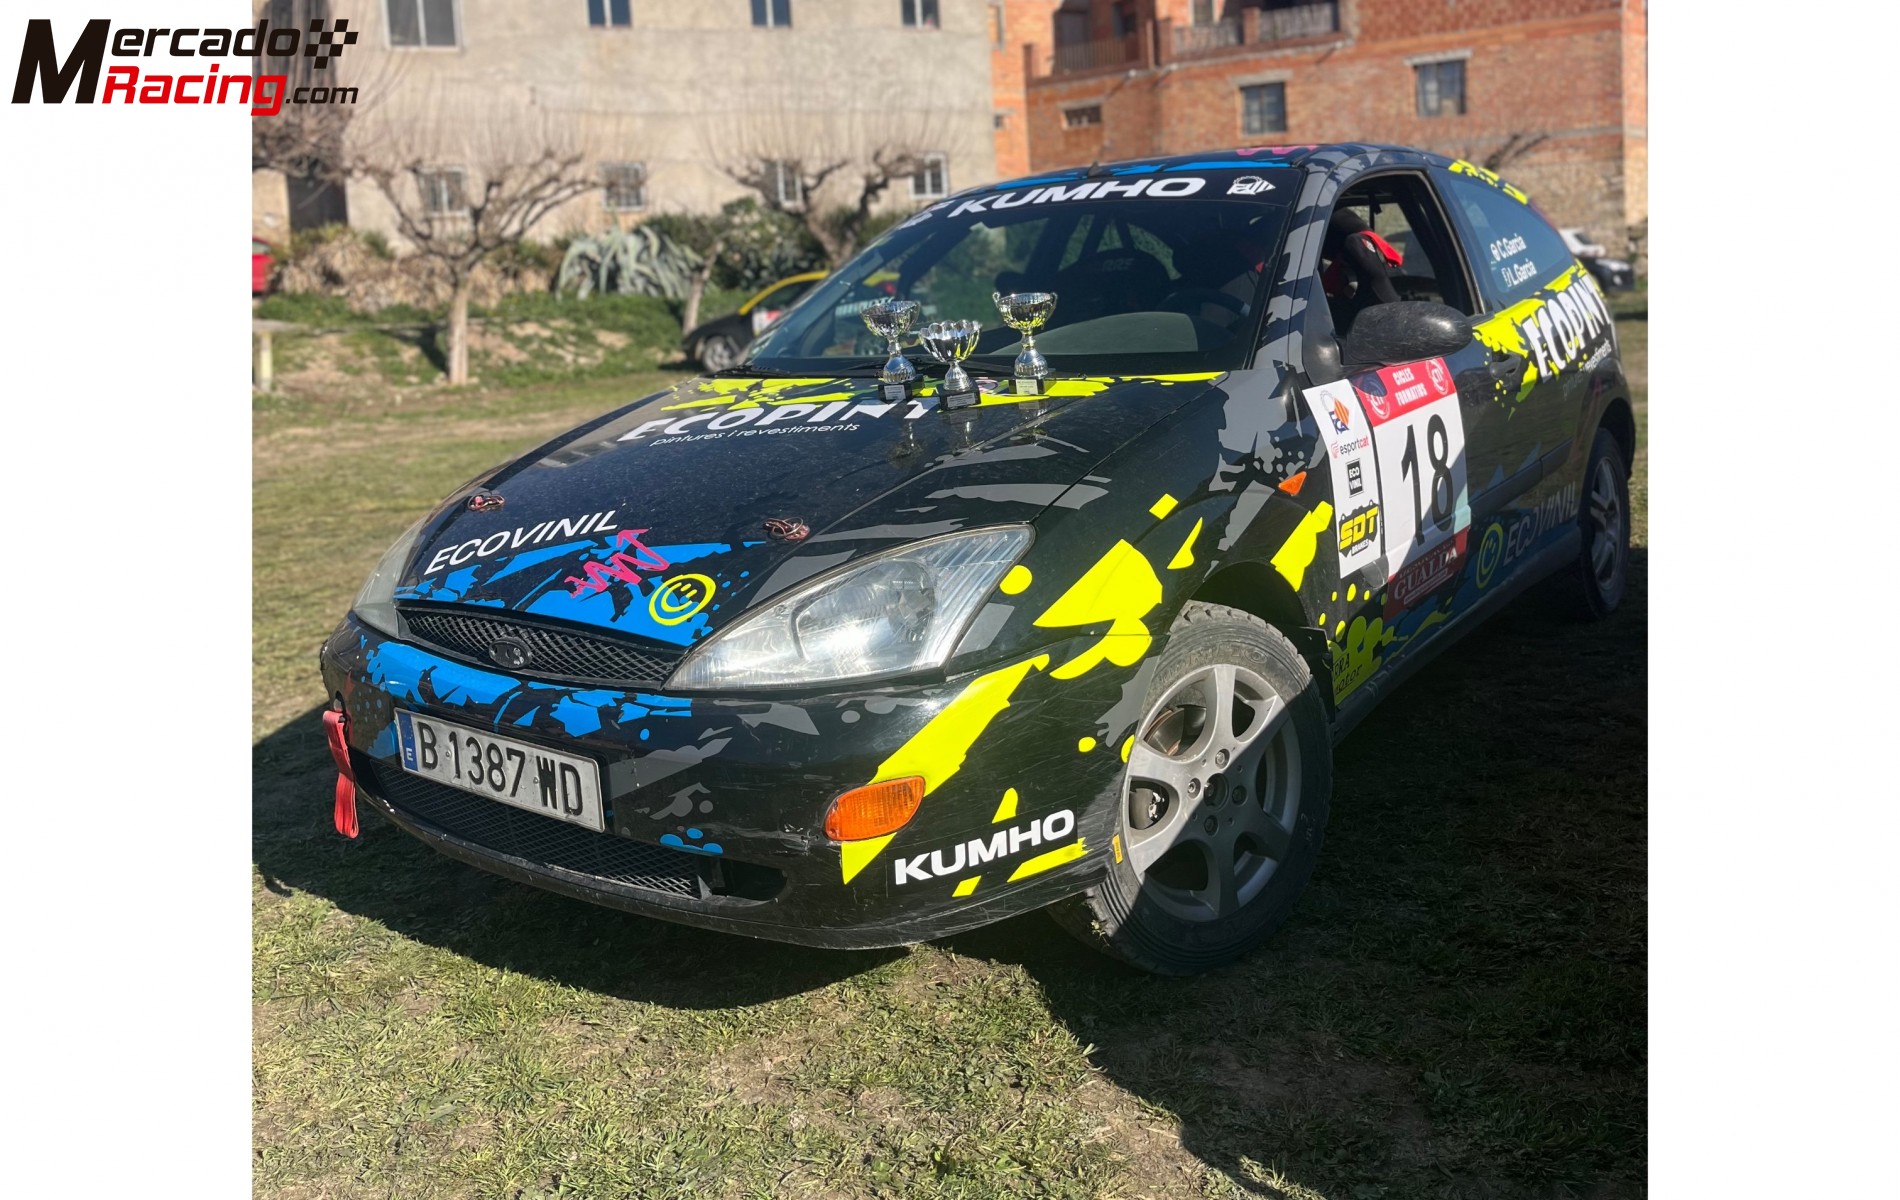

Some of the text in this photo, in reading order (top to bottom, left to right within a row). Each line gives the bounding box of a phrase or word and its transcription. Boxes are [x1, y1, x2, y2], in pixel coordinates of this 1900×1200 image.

[947, 178, 1206, 218] KUMHO
[617, 397, 940, 442] ECOPINT
[649, 423, 860, 447] pintures i revestiments
[1339, 435, 1369, 455] esportcat
[1348, 467, 1360, 479] ECO
[1401, 414, 1452, 546] 18
[423, 510, 619, 576] ECOVINIL
[1339, 506, 1378, 550] SDT
[1503, 480, 1578, 567] ECOVINIL
[405, 721, 583, 816] E B 1387 WD
[894, 809, 1075, 885] KUMHO
